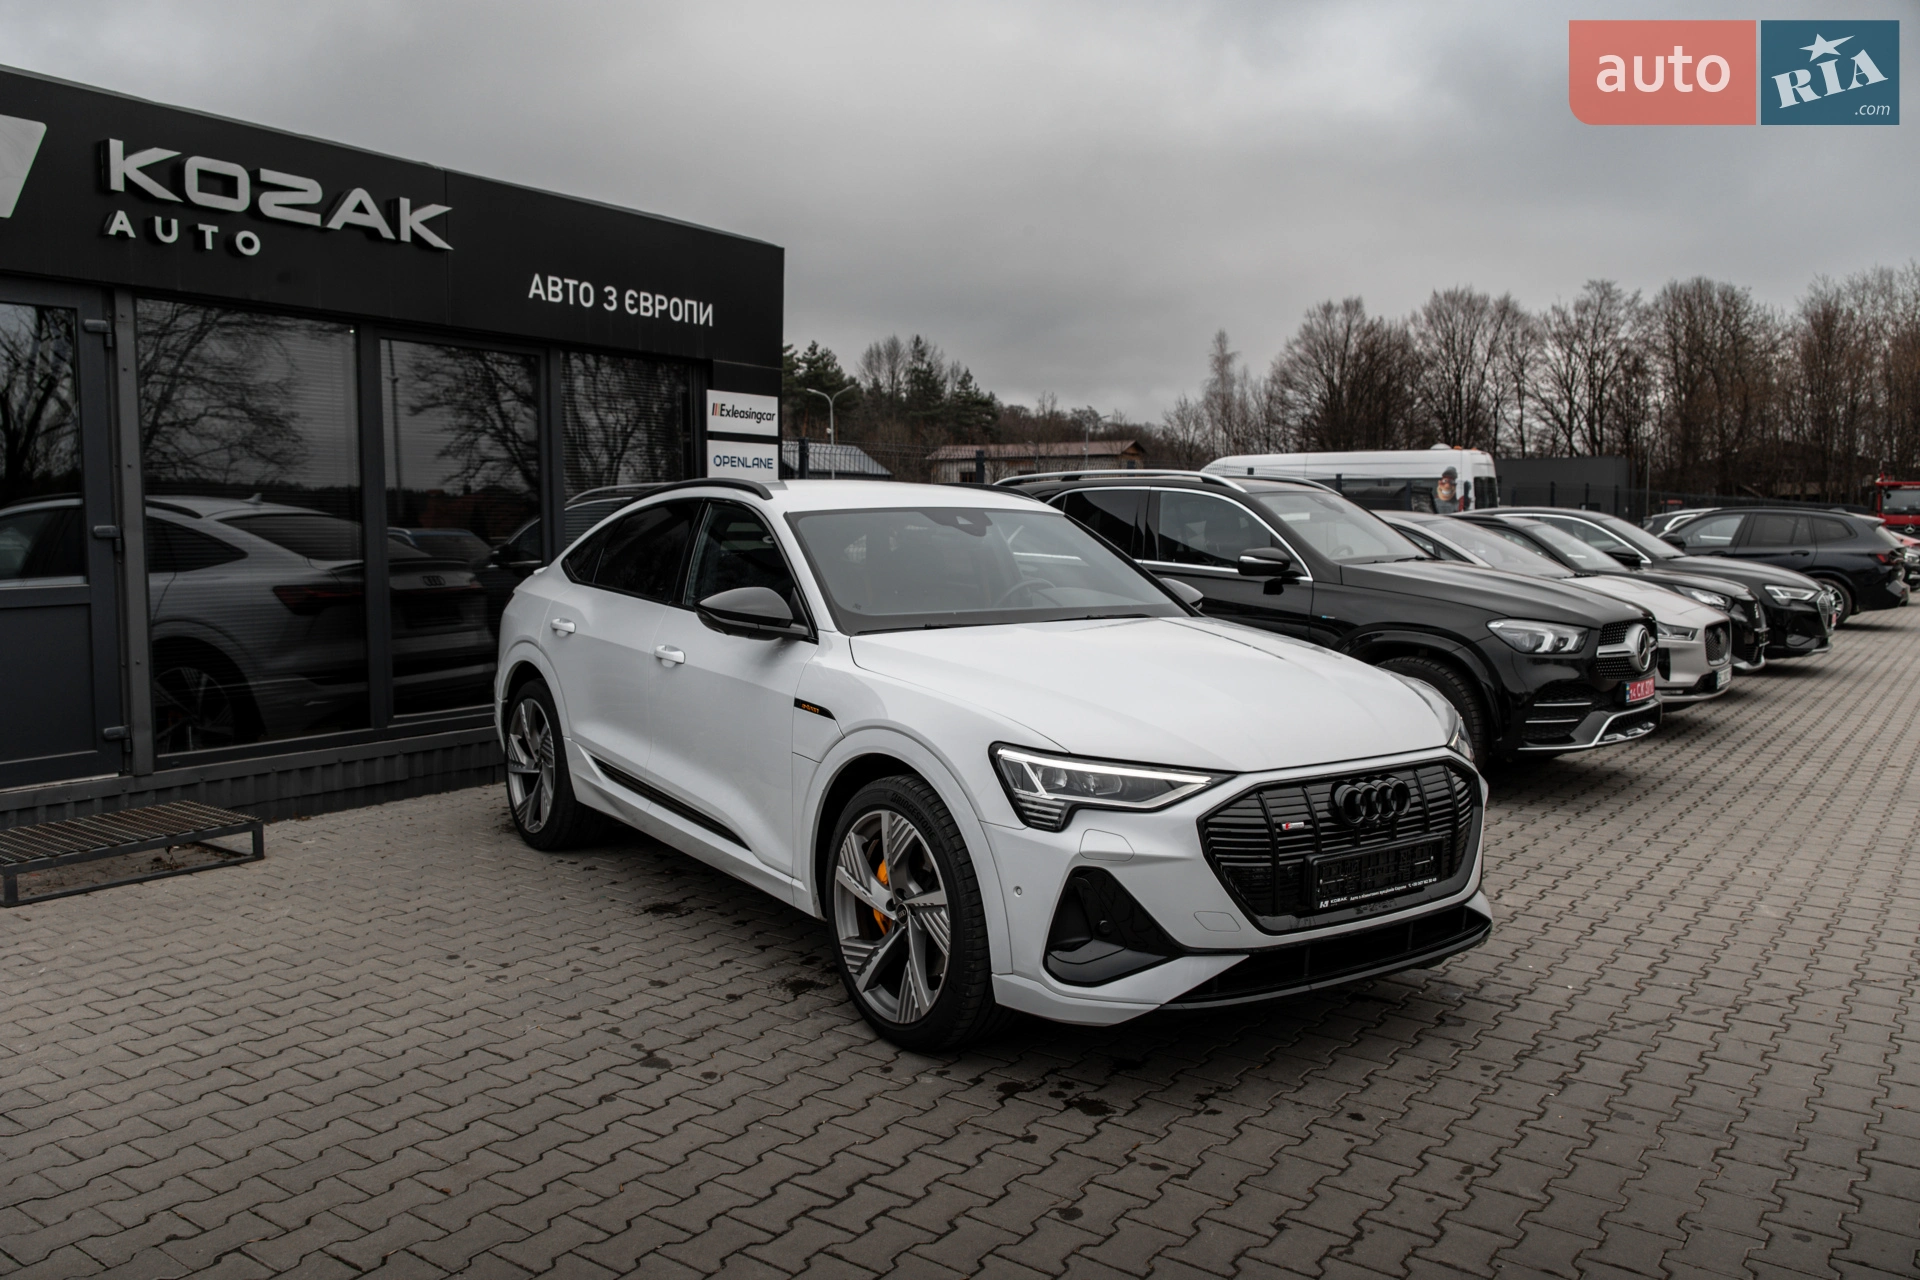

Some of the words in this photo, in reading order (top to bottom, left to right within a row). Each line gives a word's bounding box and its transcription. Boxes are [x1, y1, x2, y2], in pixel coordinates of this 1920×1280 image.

[108, 138, 454, 250] KOZAK
[108, 210, 261, 256] AUTO
[528, 273, 595, 308] АВТО
[603, 286, 617, 312] З
[624, 289, 713, 327] ЄВРОПИ
[719, 403, 776, 424] Exleasingcar
[713, 455, 773, 469] OPENLANE
[890, 792, 936, 840] BRIDGESTONE
